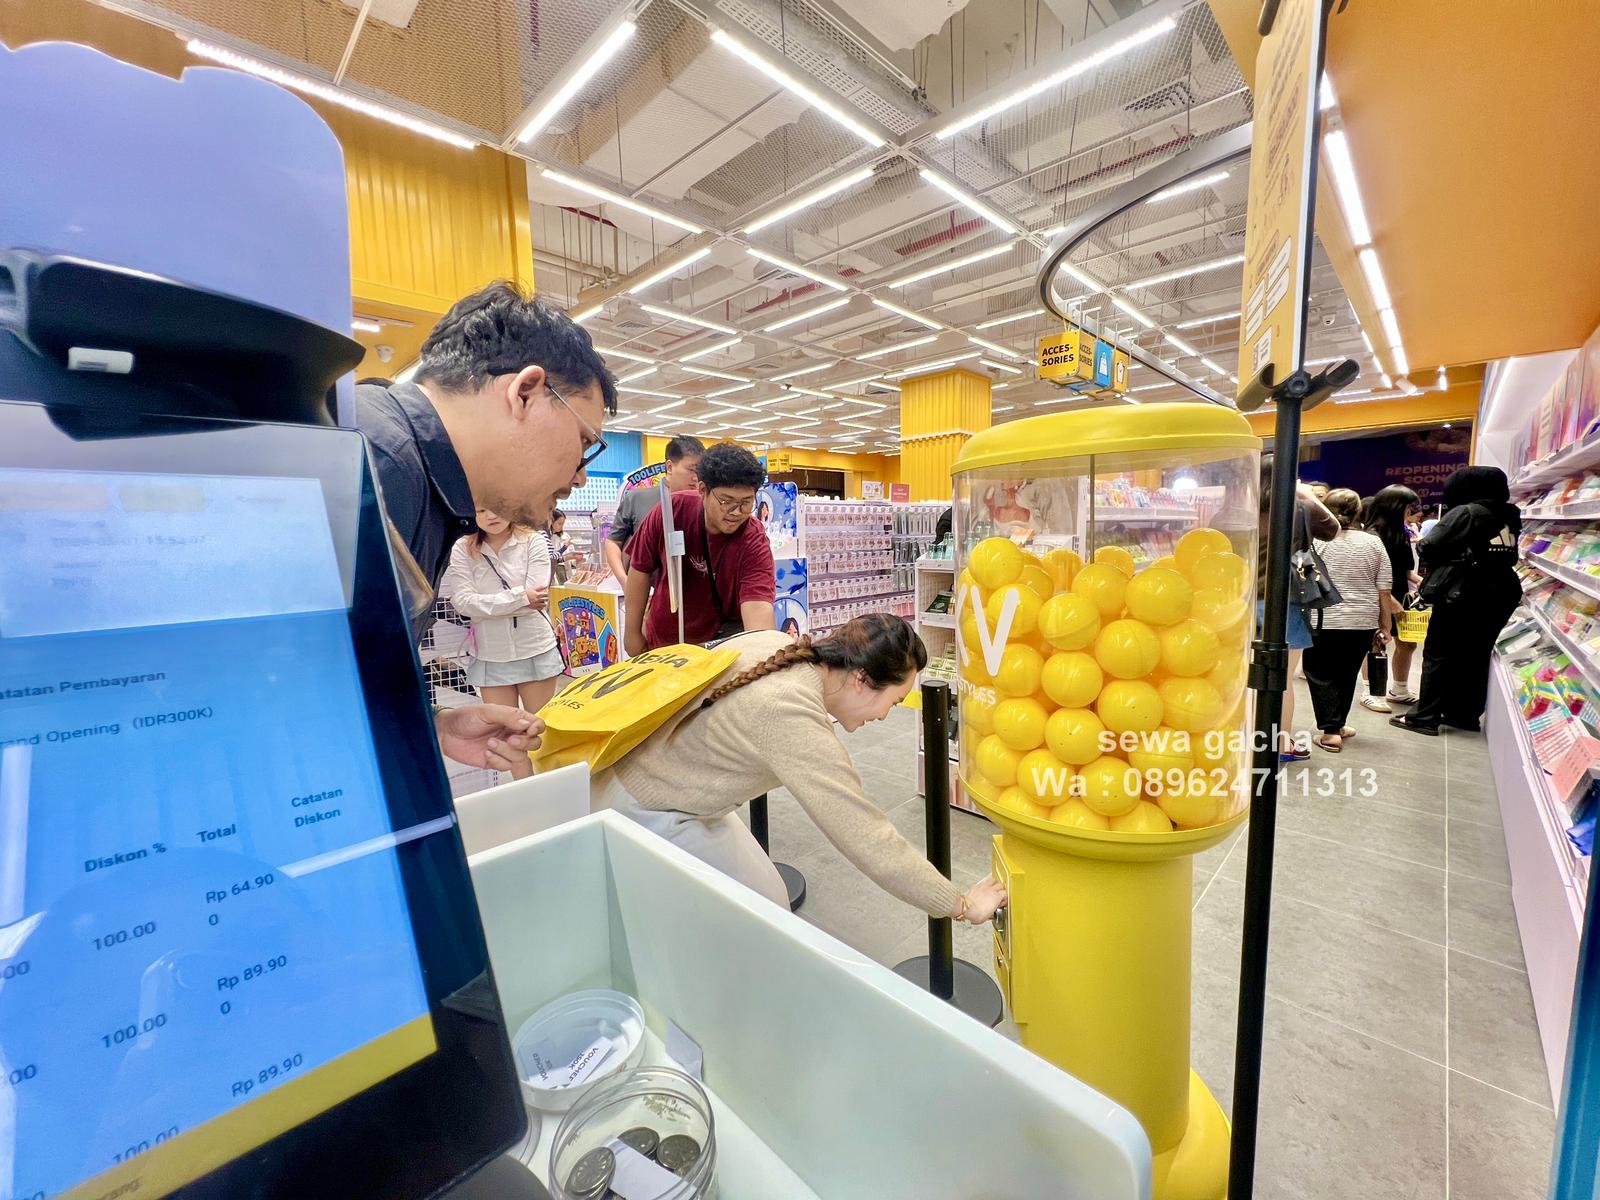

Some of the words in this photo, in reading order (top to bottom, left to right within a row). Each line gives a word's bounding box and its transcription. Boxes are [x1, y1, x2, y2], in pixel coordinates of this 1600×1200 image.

[1042, 343, 1073, 356] ACCES-
[1042, 354, 1074, 367] SORIES
[1404, 474, 1447, 485] SOON
[59, 671, 166, 693] Pembayaran
[46, 722, 120, 743] Opening
[132, 706, 213, 730] (IDR300K)
[291, 788, 343, 808] Catatan
[294, 807, 341, 828] Diskon
[197, 823, 237, 843] Total
[84, 848, 148, 873] Diskon
[152, 842, 167, 854] %
[206, 890, 227, 904] Rp
[231, 873, 275, 896] 64.90
[208, 914, 219, 926] 0
[93, 921, 156, 950] 100.00
[217, 975, 239, 991] Rp
[243, 955, 287, 981] 89.90
[220, 1001, 231, 1015] 0
[102, 1013, 168, 1049] 100.00
[231, 1079, 253, 1096] Rp
[258, 1053, 303, 1084] 89.90
